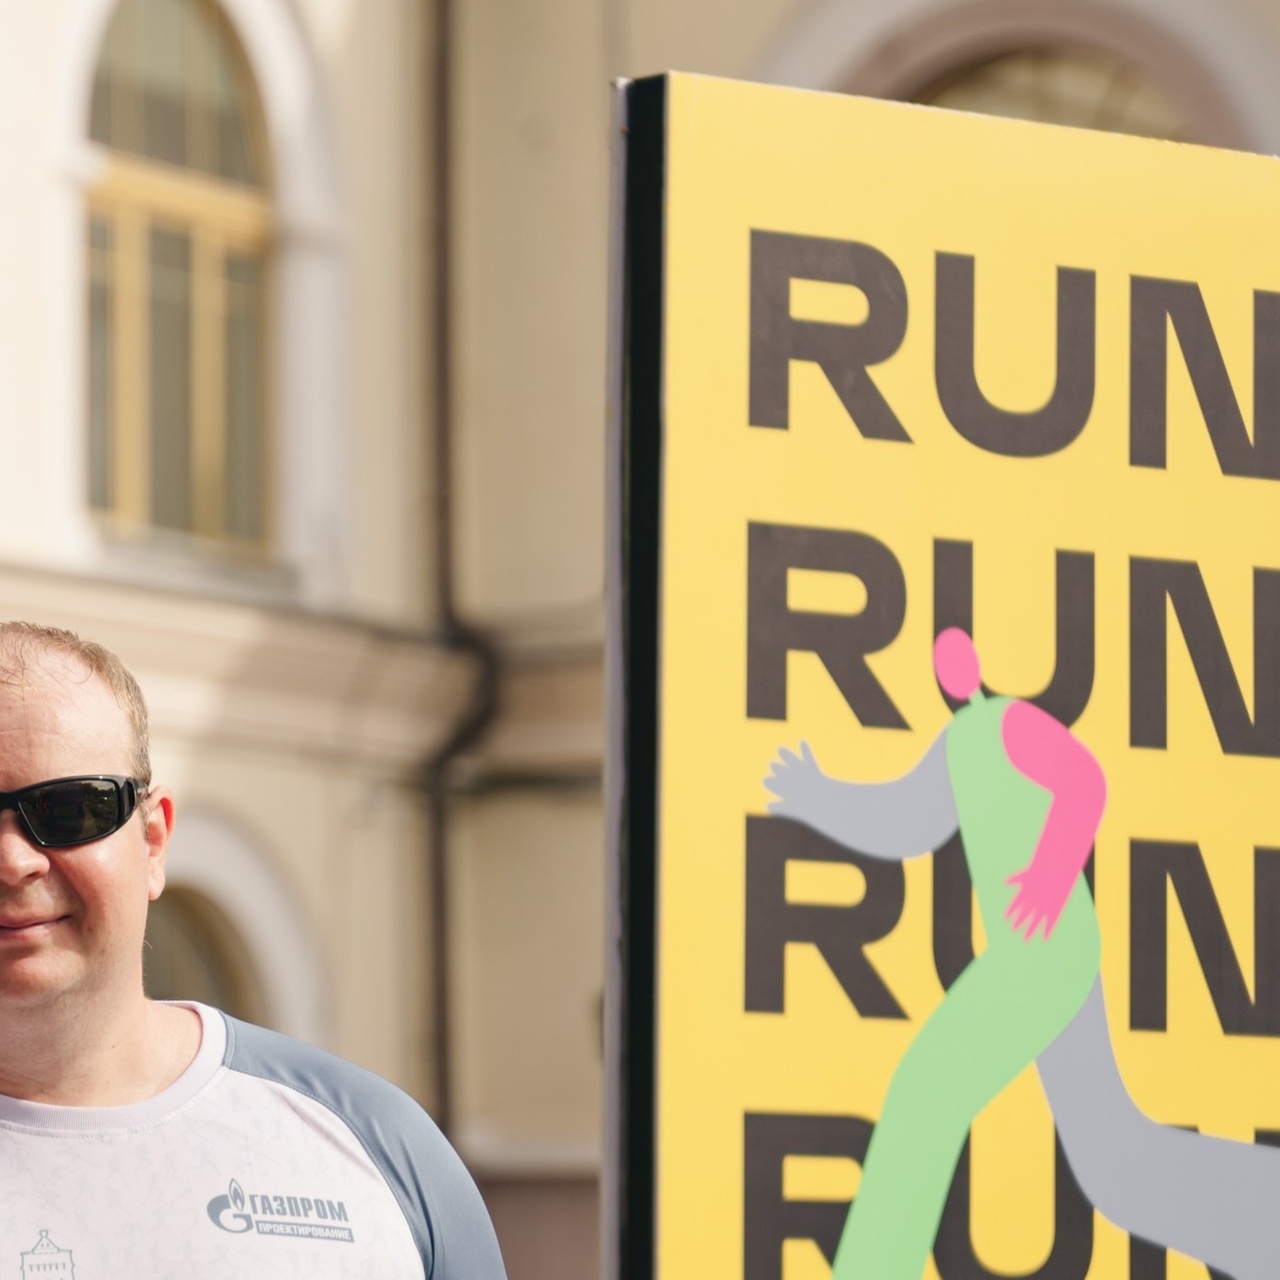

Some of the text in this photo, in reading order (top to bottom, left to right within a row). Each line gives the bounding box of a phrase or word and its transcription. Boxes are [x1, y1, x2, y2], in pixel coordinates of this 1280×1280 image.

[749, 227, 1280, 481] RUN
[249, 1194, 349, 1222] ГАЗПРОМ
[258, 1222, 352, 1241] ПРОЕКТИРОВАНИЕ
